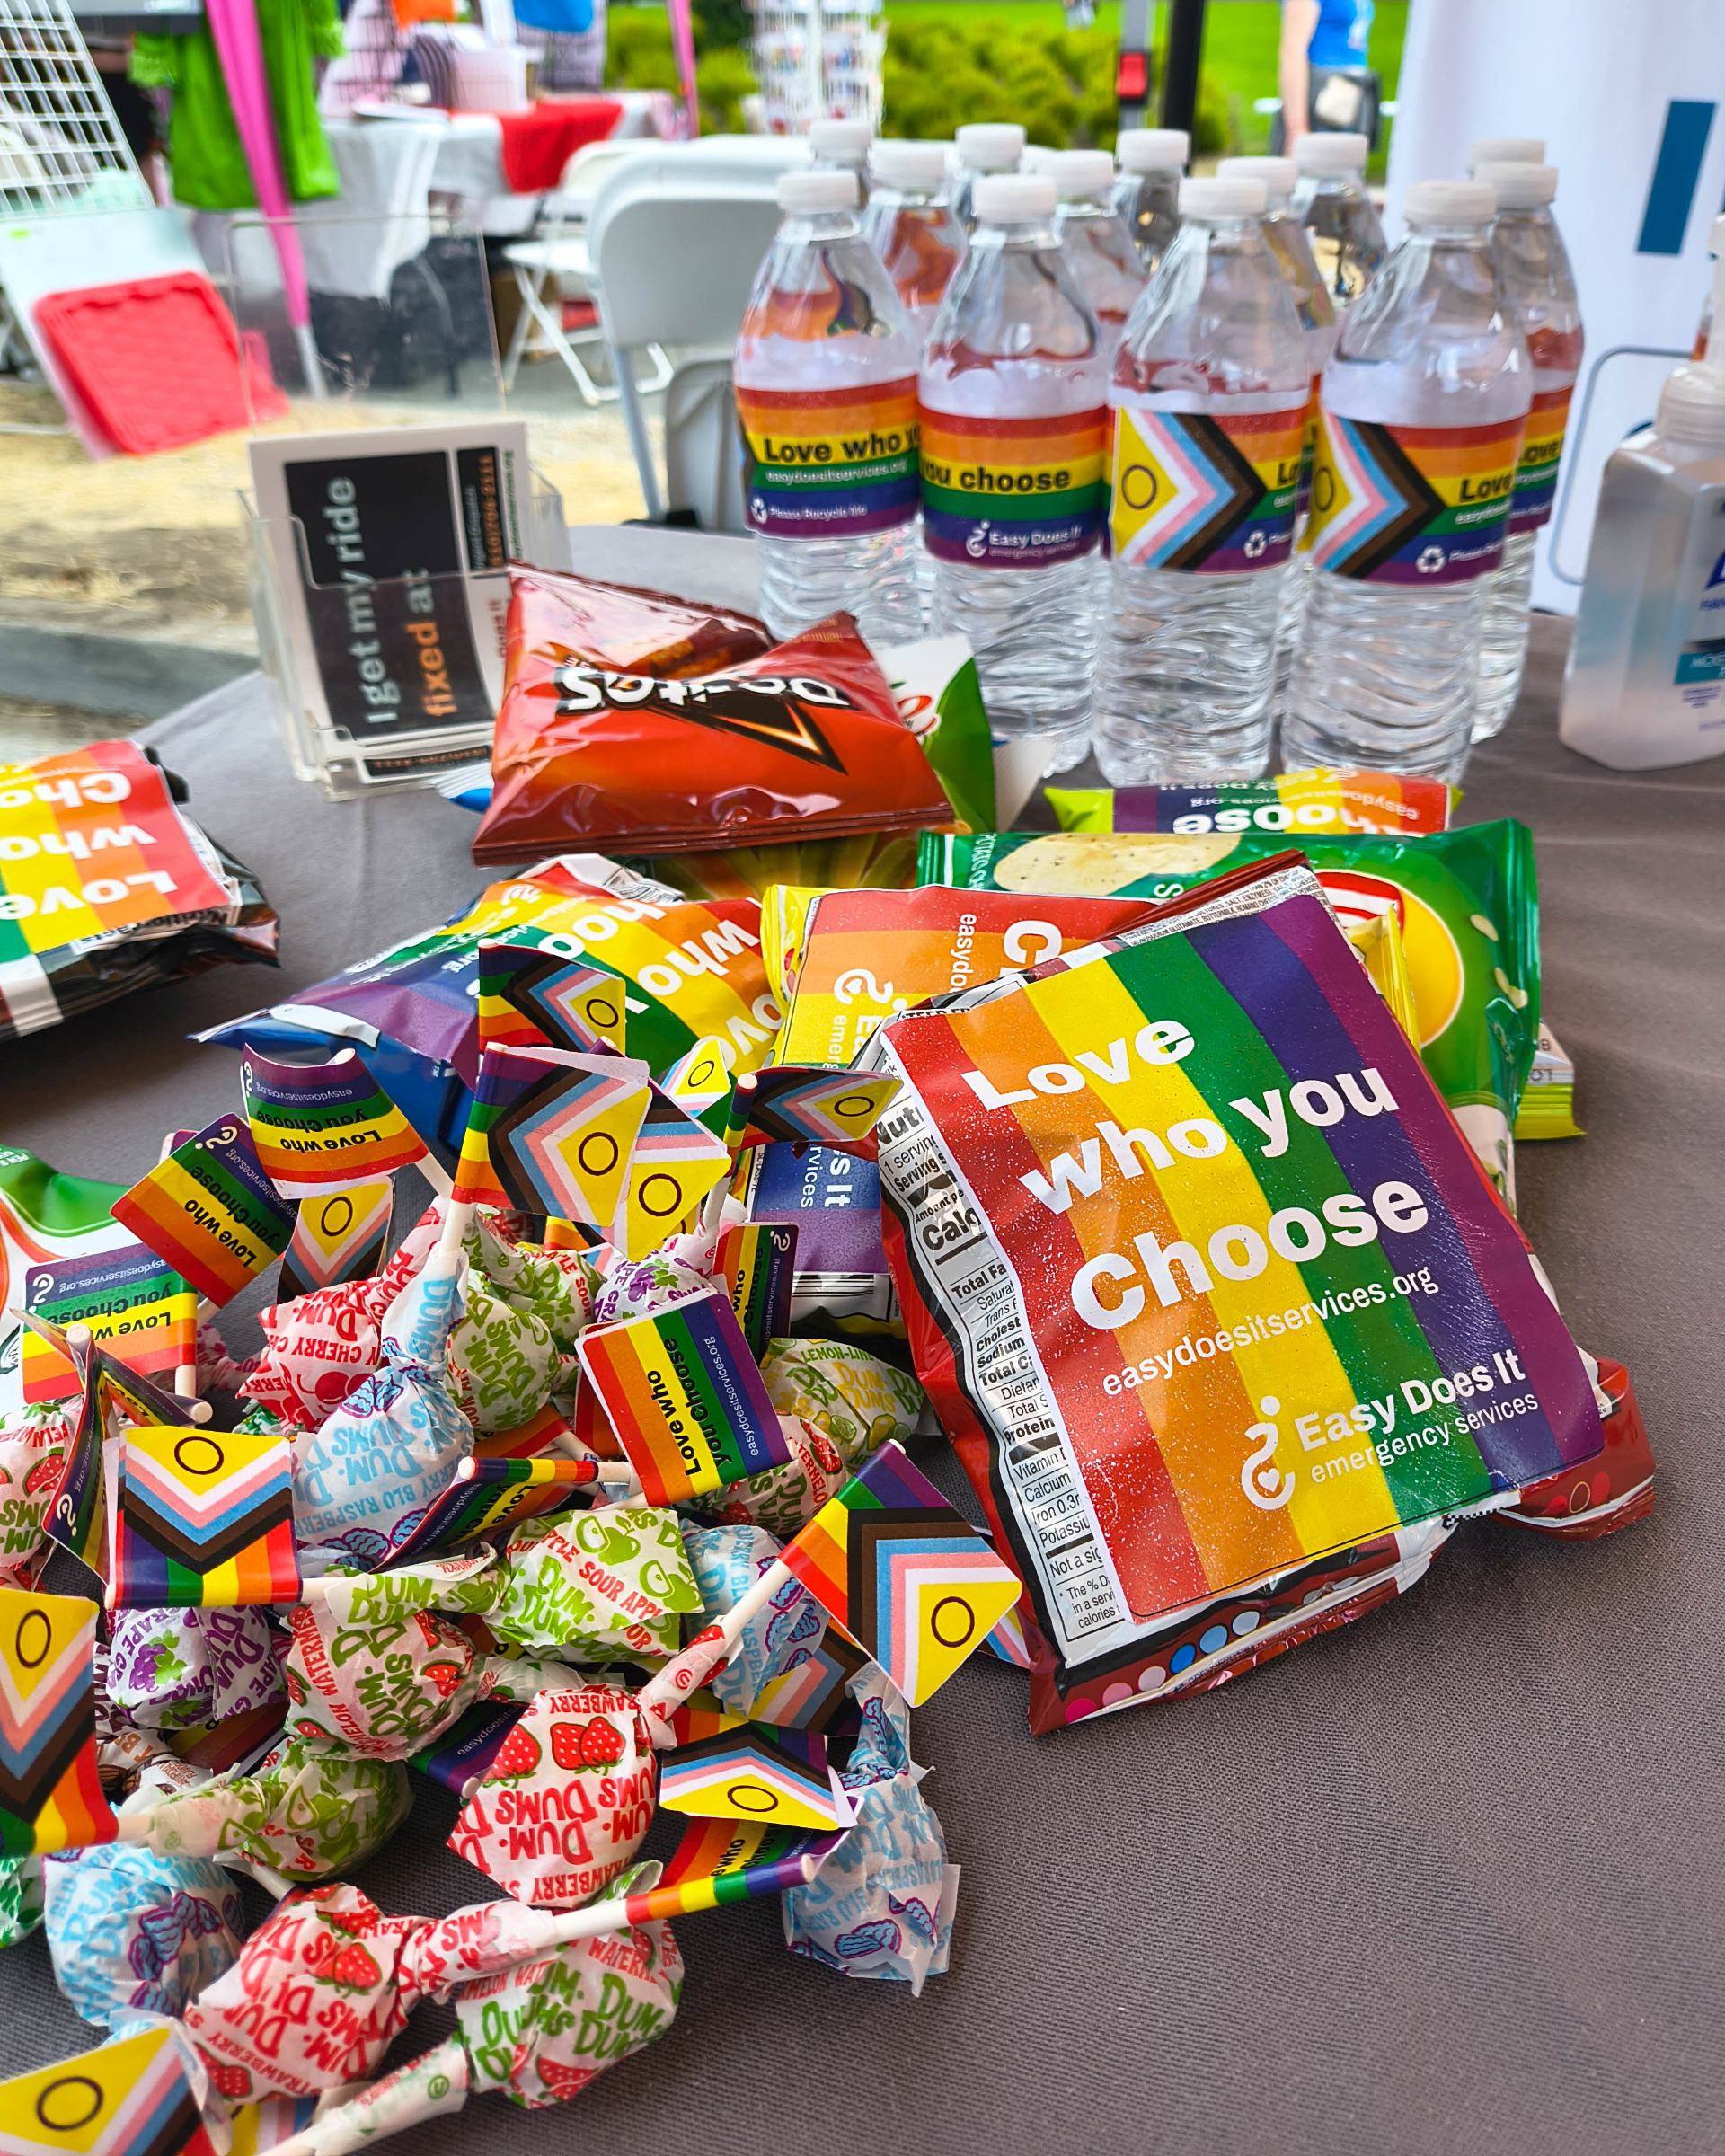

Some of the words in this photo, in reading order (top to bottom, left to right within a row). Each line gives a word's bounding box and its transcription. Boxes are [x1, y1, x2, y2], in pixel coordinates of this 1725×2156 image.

[765, 438, 833, 462] Love
[842, 432, 901, 458] who
[921, 459, 951, 486] you
[960, 465, 1071, 492] choose
[323, 476, 364, 564] ride
[989, 533, 1031, 549] Easy
[340, 569, 379, 634] my
[400, 567, 434, 614] at
[349, 642, 401, 706] get
[405, 621, 457, 716] fixed
[0, 825, 156, 861] who
[0, 870, 179, 920] Love
[636, 920, 761, 996] who
[961, 1019, 1195, 1110] Love
[256, 1082, 353, 1102] easydoesitservices.org
[323, 1109, 374, 1132] you
[279, 1137, 322, 1154] who
[323, 1129, 383, 1151] Love
[1018, 1116, 1226, 1215] who
[1228, 1066, 1399, 1157] you
[800, 1146, 824, 1208] rvices
[894, 1155, 941, 1192] Serving
[824, 1184, 853, 1208] It
[183, 1198, 220, 1236] who
[242, 1216, 281, 1248] you
[218, 1227, 258, 1268] Love
[58, 1259, 168, 1294] asydoesitservices.org
[733, 1268, 747, 1312] who
[951, 1269, 990, 1300] Total
[133, 1287, 172, 1308] you
[575, 1276, 592, 1319] SOUR
[118, 1312, 172, 1336] Love
[984, 1304, 1010, 1329] Trans
[1102, 1267, 1440, 1396] easydoesitservices.org
[291, 1337, 361, 1363] CHERRY
[976, 1317, 1022, 1352] Cholest
[486, 1319, 537, 1401] DUMS
[800, 1347, 875, 1364] LEMON-LIME
[978, 1337, 1025, 1368] Sodium
[978, 1363, 1016, 1387] Total
[646, 1370, 677, 1421] who
[703, 1335, 760, 1457] easydoesitservices.org
[1008, 1401, 1038, 1419] Total
[1295, 1393, 1396, 1451] Easy
[1402, 1360, 1491, 1417] Does
[1495, 1348, 1526, 1385] It
[667, 1421, 703, 1476] Love
[697, 1423, 734, 1469] you
[1004, 1417, 1056, 1446] Protein
[1310, 1422, 1450, 1484] emergency
[1455, 1392, 1538, 1436] services
[1013, 1451, 1059, 1480] Vitamin
[382, 1484, 416, 1511] BLU
[491, 1484, 537, 1524] Love
[1024, 1473, 1072, 1504] Calcium
[579, 1560, 625, 1603] SOUR
[1049, 1559, 1074, 1578] Not
[1075, 1552, 1084, 1567] a
[1066, 1584, 1087, 1601] The
[1073, 1601, 1084, 1614] in
[1084, 1599, 1092, 1610] a
[1078, 1605, 1115, 1629] calories
[494, 1778, 599, 1825] DUMS
[721, 1837, 747, 1870] who
